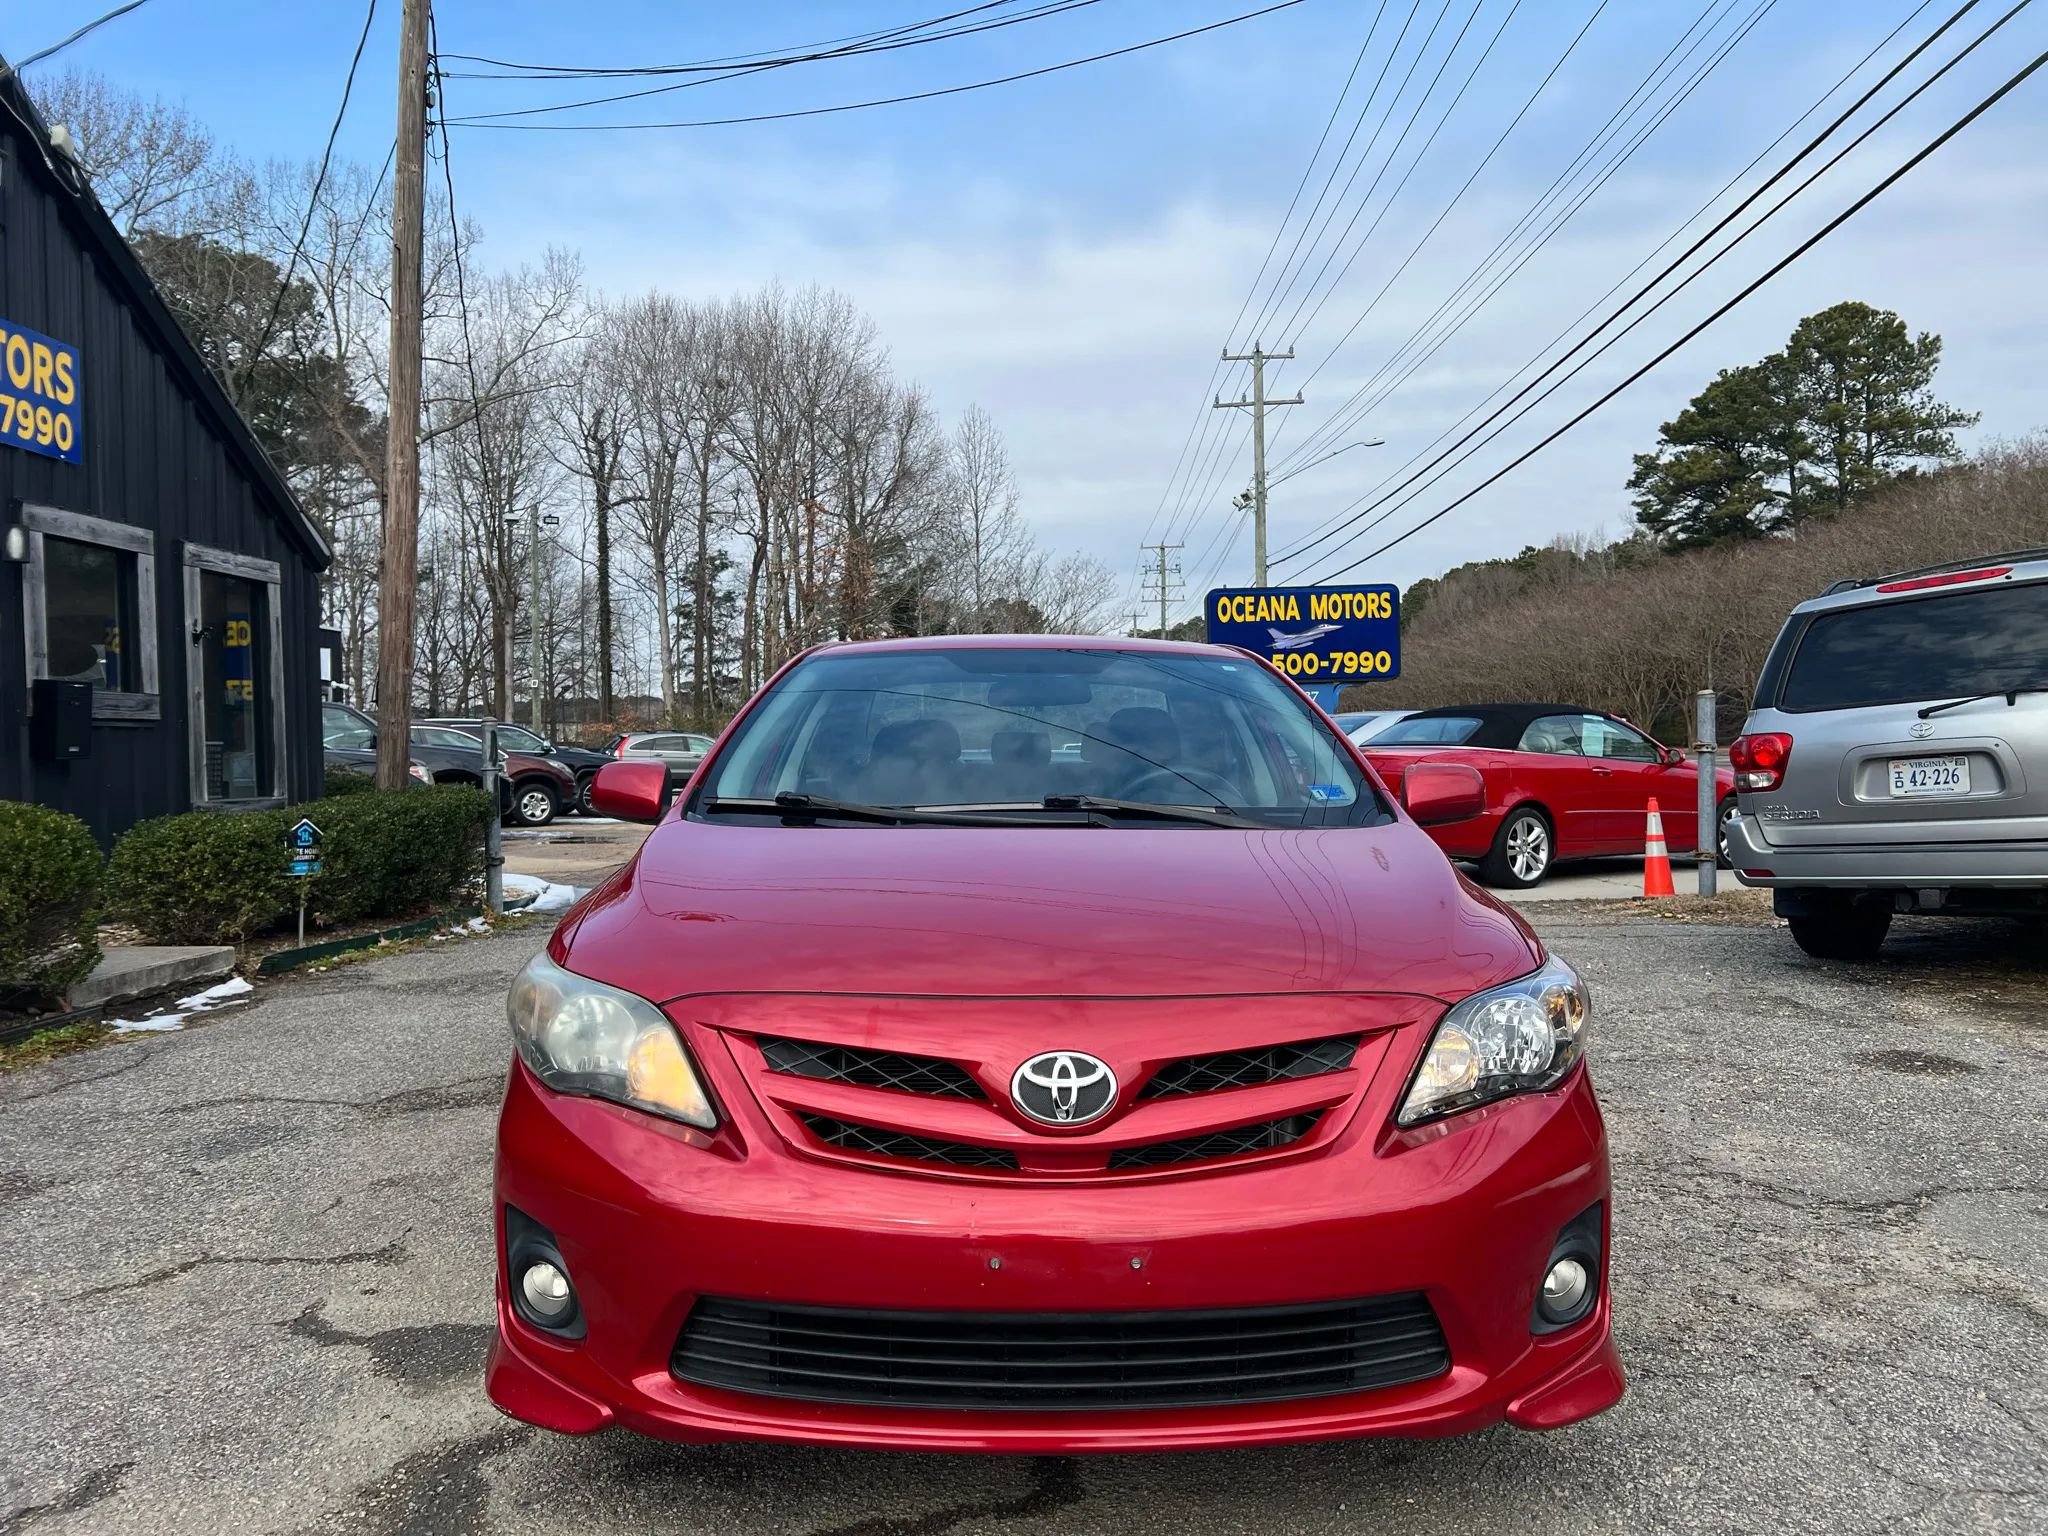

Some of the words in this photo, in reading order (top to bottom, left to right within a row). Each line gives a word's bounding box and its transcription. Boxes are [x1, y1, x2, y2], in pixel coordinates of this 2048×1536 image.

[0, 394, 73, 451] 7990
[1217, 595, 1300, 623] OCEANA
[1310, 592, 1392, 620] MOTORS
[1272, 651, 1391, 676] 500-7990
[1909, 760, 1948, 769] VIRGINIA
[1909, 768, 1960, 787] 42-226
